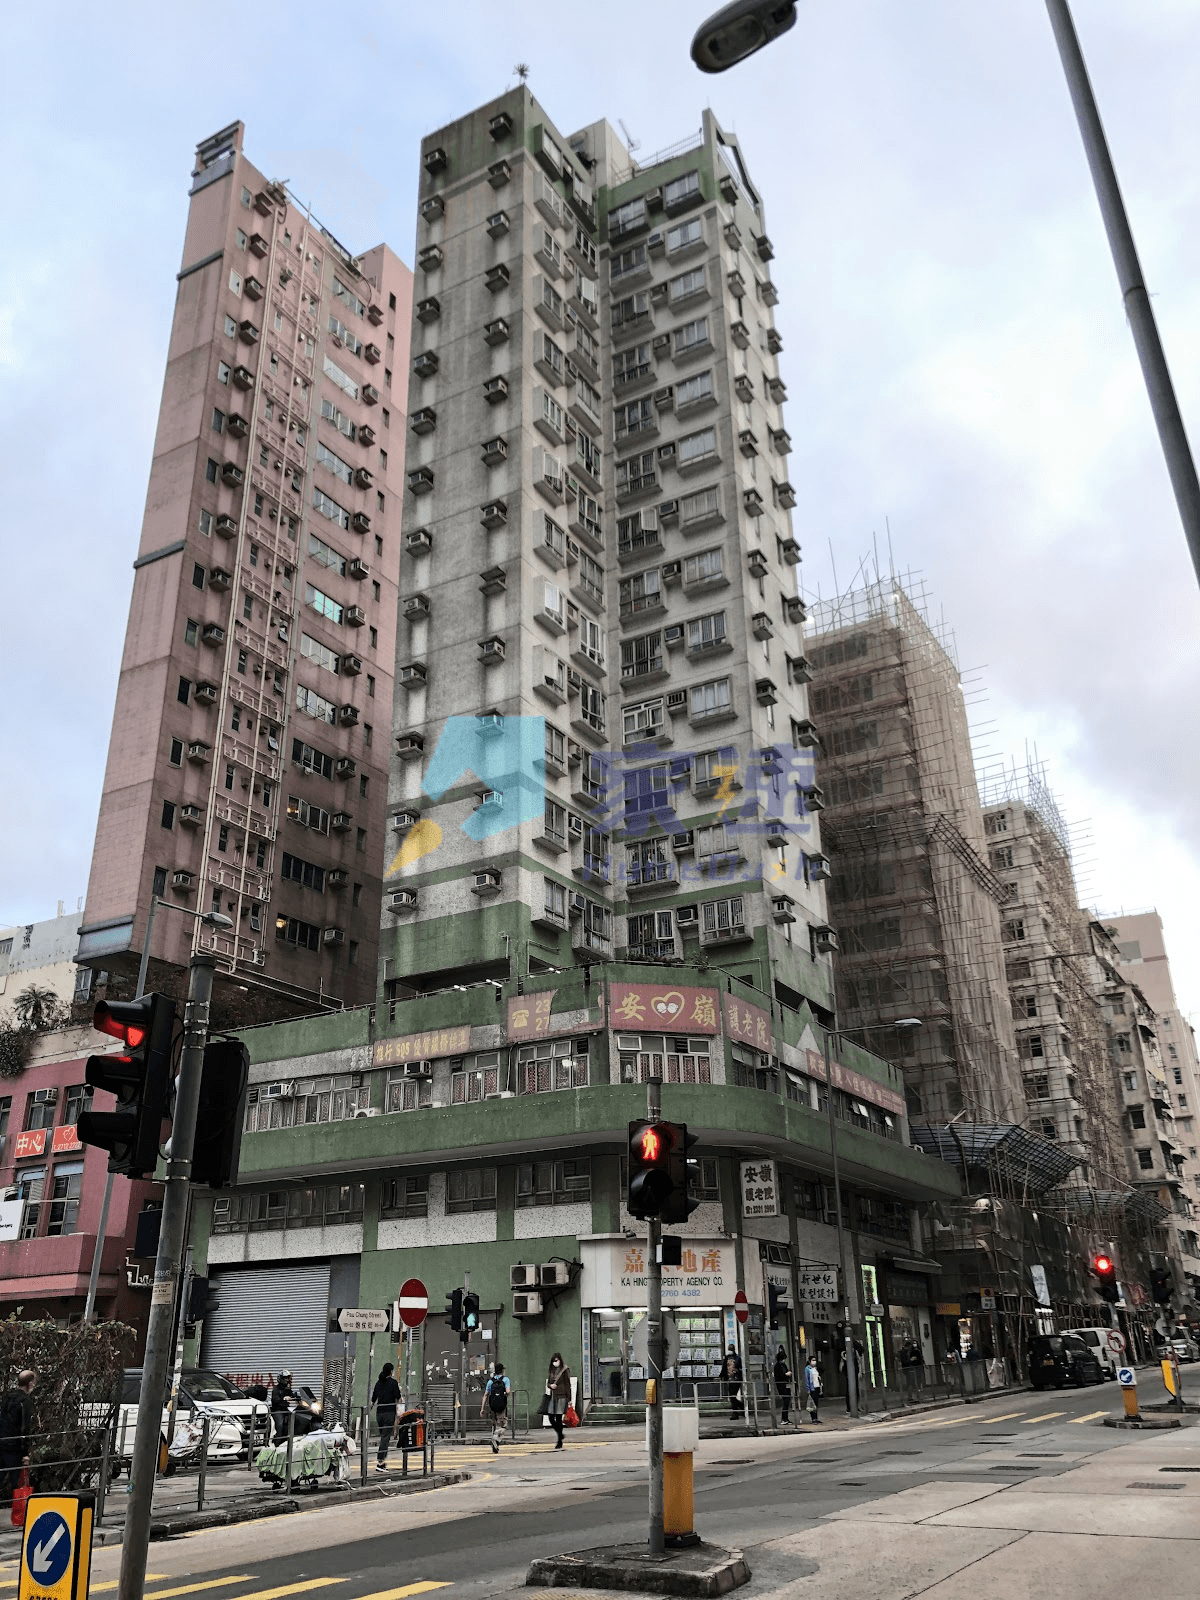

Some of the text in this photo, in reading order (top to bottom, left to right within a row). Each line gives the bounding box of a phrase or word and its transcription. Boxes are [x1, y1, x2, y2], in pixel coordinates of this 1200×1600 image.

[728, 1004, 769, 1045] 護老院
[623, 1248, 722, 1273] 嘉地產
[621, 1277, 631, 1287] KA
[633, 1277, 648, 1287] HING
[686, 1277, 710, 1286] AGENCY
[713, 1276, 723, 1286] CO.
[801, 1273, 833, 1285] 新世紀
[682, 1289, 701, 1297] 4382
